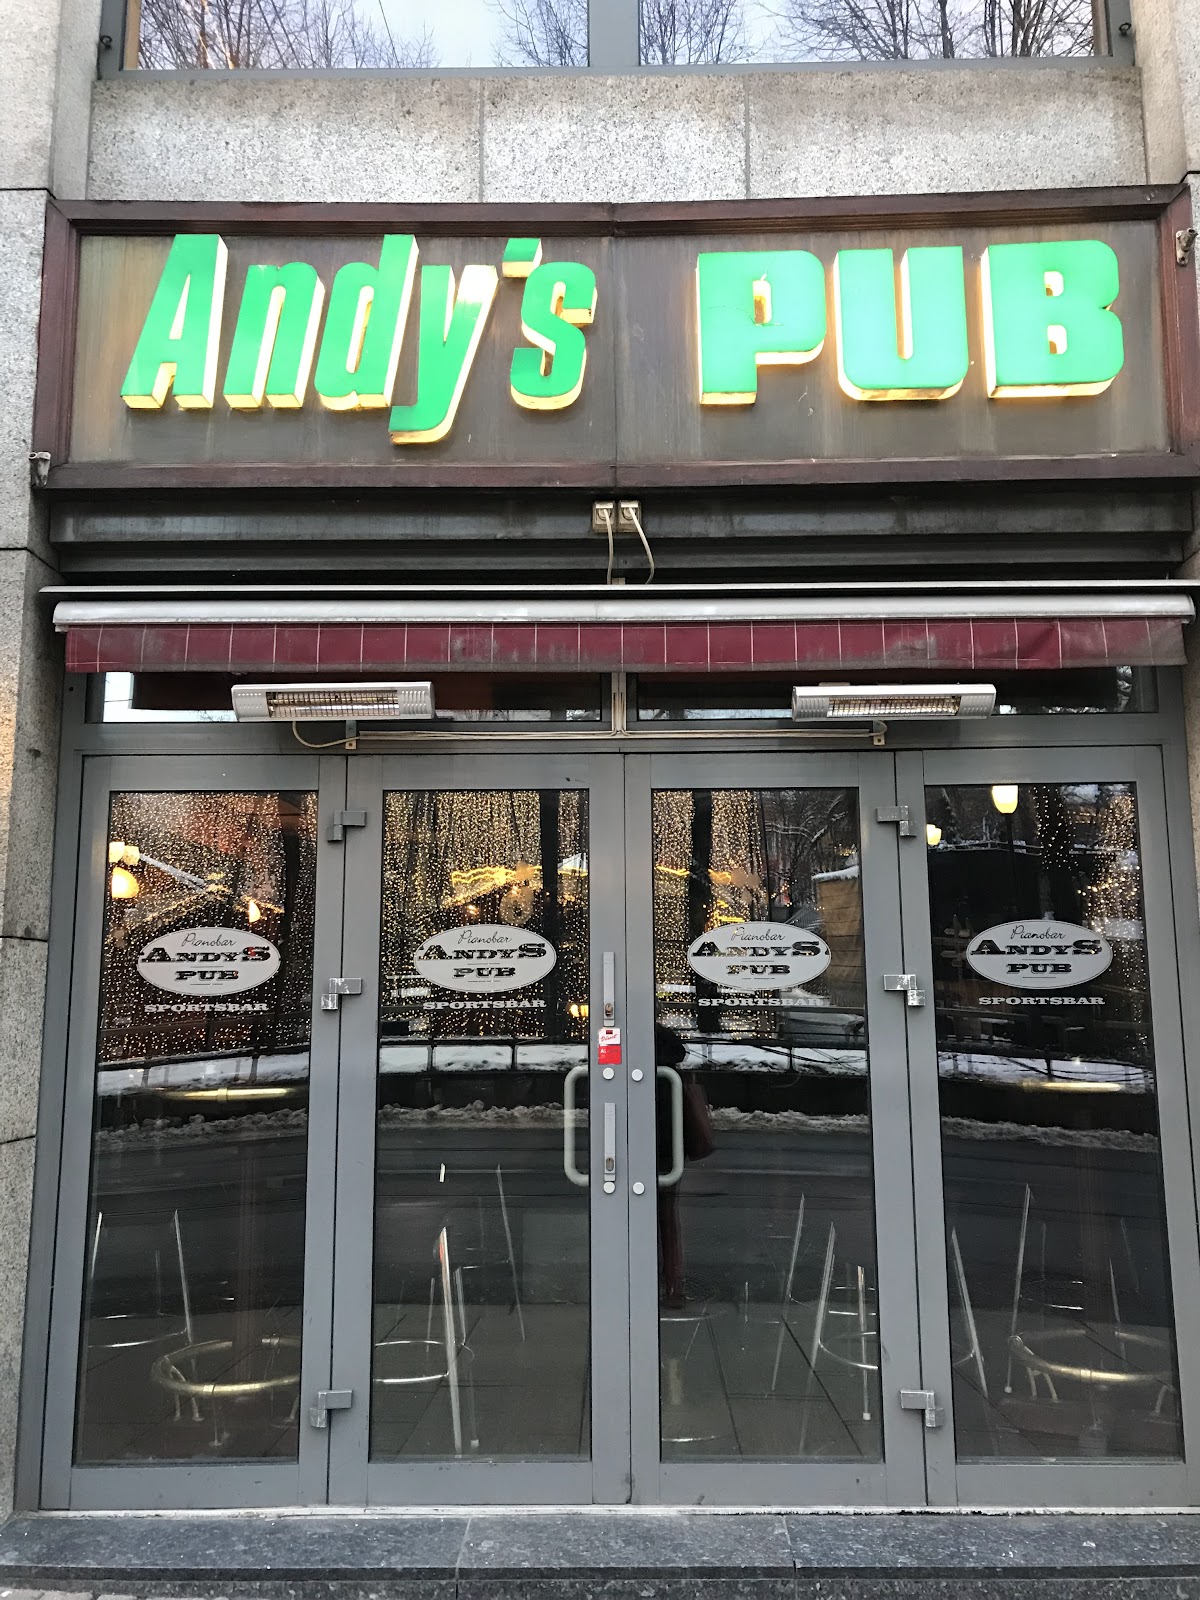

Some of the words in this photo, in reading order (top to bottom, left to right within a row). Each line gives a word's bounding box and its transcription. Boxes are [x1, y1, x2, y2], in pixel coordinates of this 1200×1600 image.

[120, 233, 598, 446] Andy's
[694, 239, 1125, 407] PUB
[457, 930, 513, 944] Pianobar
[730, 926, 786, 941] Pianobar
[1010, 925, 1066, 939] Pianobar
[181, 932, 237, 947] Pianobar
[452, 967, 517, 978] PUB
[726, 964, 791, 975] PUB
[1006, 963, 1072, 974] PUB
[174, 970, 239, 981] PUB
[422, 1000, 547, 1010] SPORTSBAR
[698, 998, 826, 1007] SPORTSBAR
[978, 997, 1106, 1006] SPORTSBAR
[144, 1003, 270, 1013] SPORTSBAR
